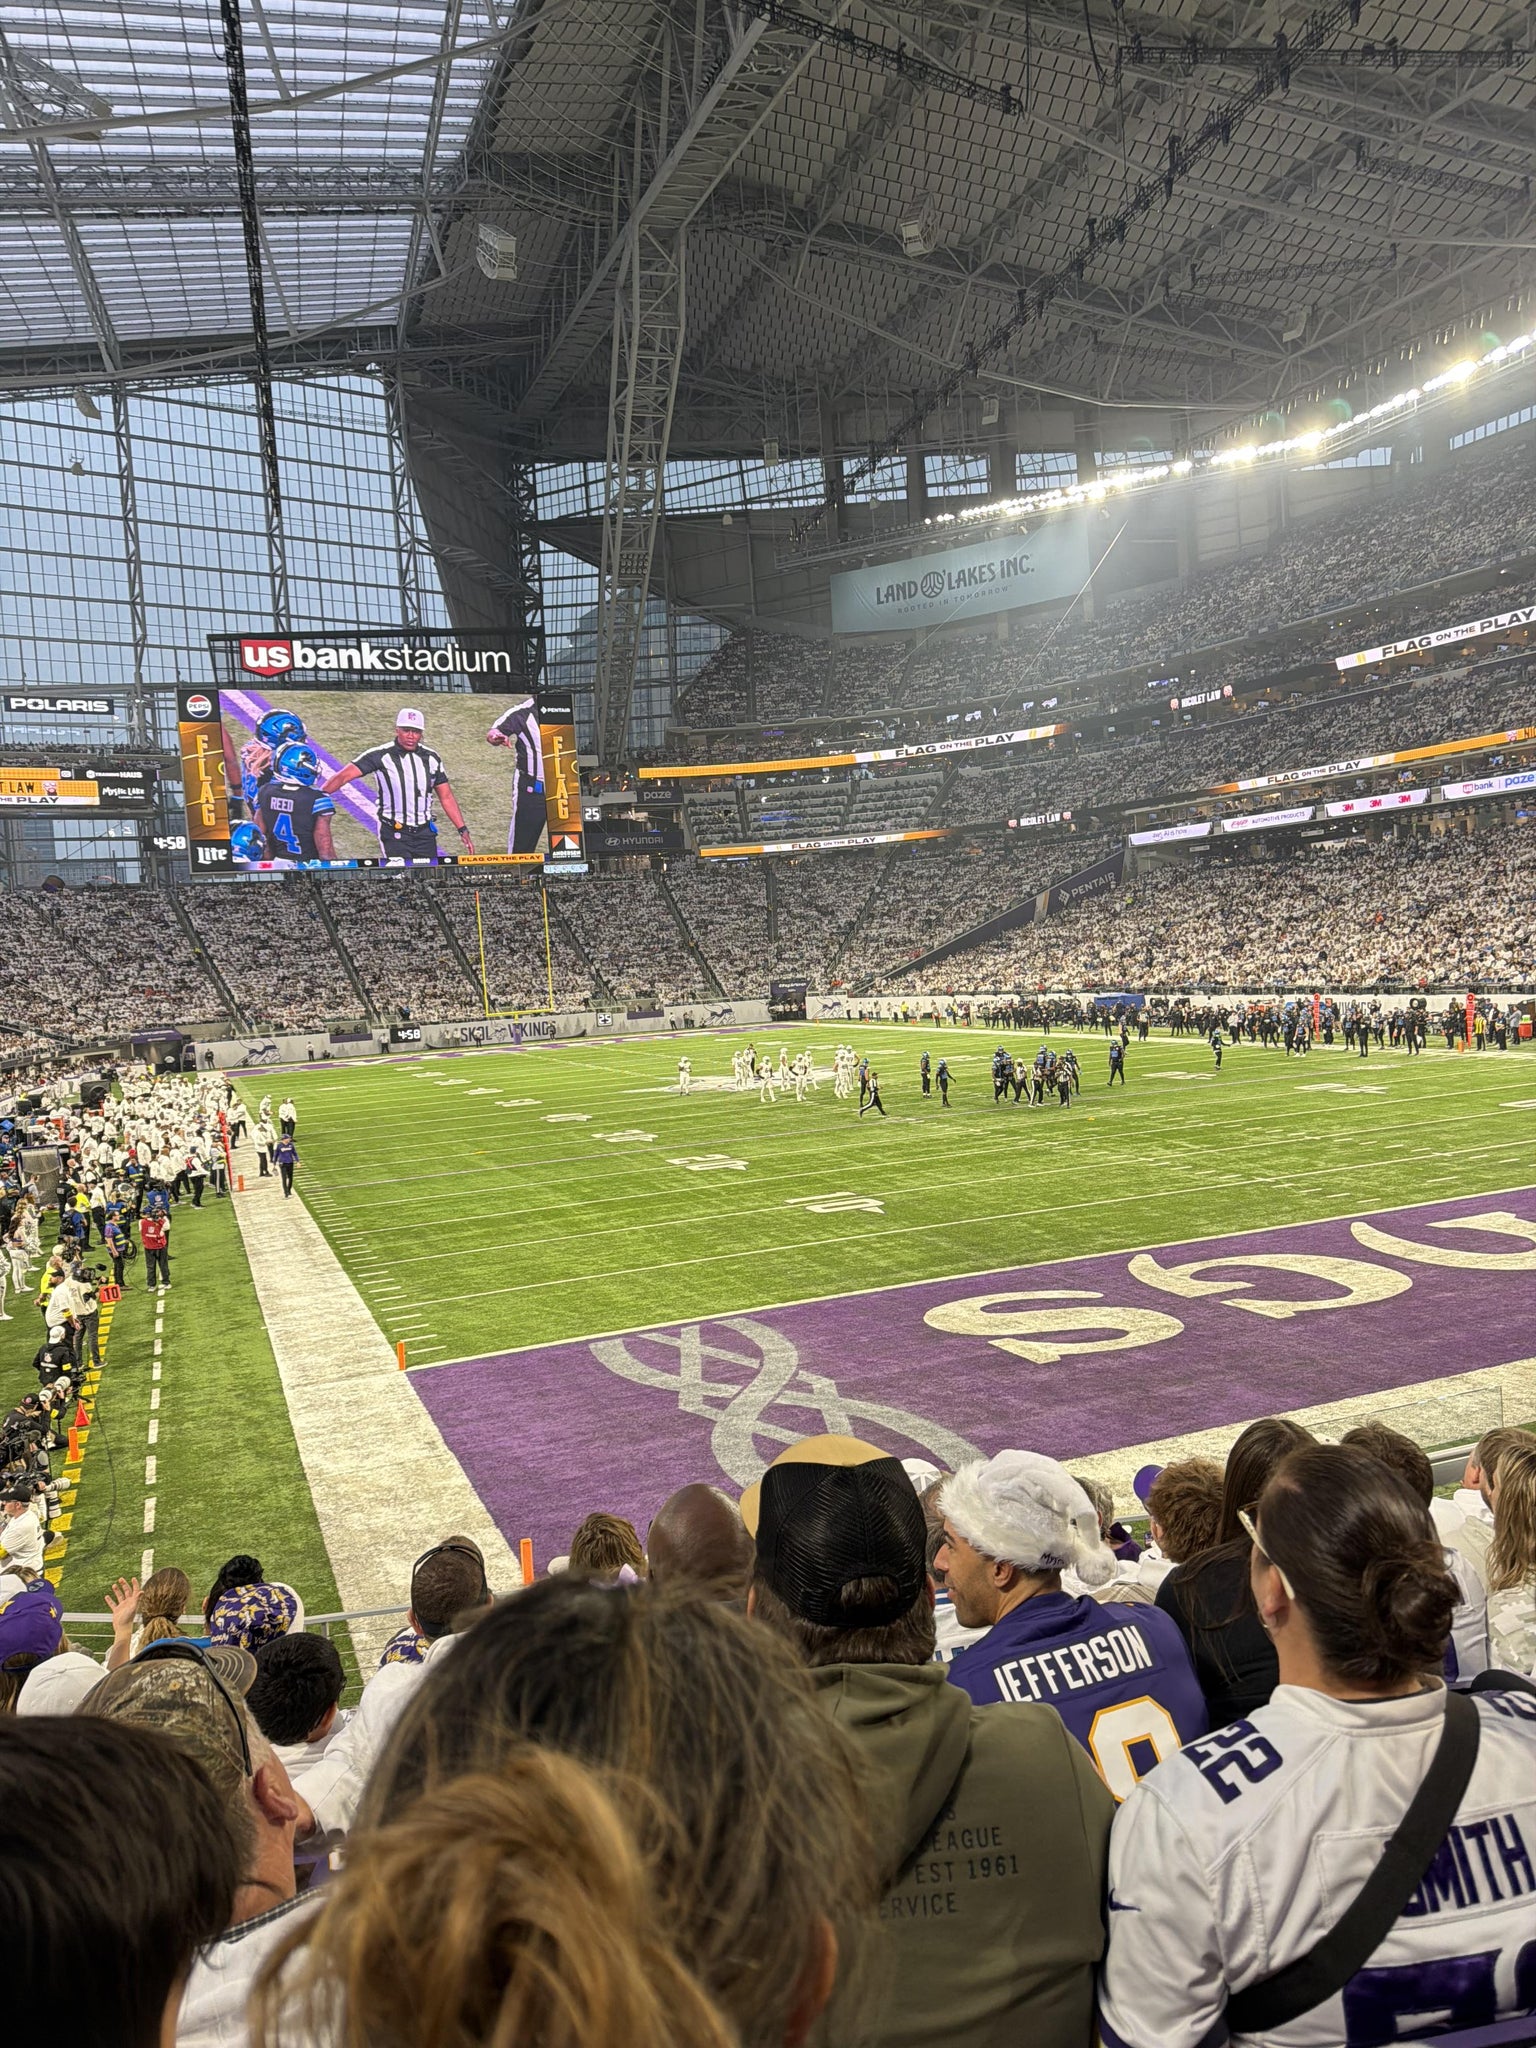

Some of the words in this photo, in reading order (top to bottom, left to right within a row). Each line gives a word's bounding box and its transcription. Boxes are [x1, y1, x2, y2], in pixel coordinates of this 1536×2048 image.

[876, 581, 918, 605] LAND
[1000, 554, 1035, 579] INC.
[898, 601, 934, 614] ROOTED
[954, 587, 1009, 602] TOMORROW
[1382, 637, 1432, 658] FLAG
[1435, 632, 1451, 642] ON
[1455, 625, 1476, 638] THE
[1480, 608, 1535, 633] PLAY
[10, 698, 109, 712] POLARIS
[895, 744, 937, 757] FLAG
[975, 733, 1015, 746] PLAY
[196, 735, 215, 826] FLAG
[553, 736, 569, 820] FLAG
[1267, 773, 1299, 784] FLAG
[1329, 761, 1360, 773] PLAY
[1474, 780, 1493, 791] bank
[1505, 774, 1535, 787] paze
[9, 782, 34, 793] LAW
[643, 791, 672, 800] paze
[271, 796, 294, 813] REED
[585, 808, 600, 820] 25
[1342, 803, 1354, 812] 3M
[1369, 799, 1381, 808] 3M
[1398, 794, 1411, 804] 3M
[154, 836, 187, 849] 4:58
[273, 813, 303, 854] 4
[622, 837, 663, 845] HYUNDAI
[847, 837, 876, 845] PLAY
[197, 846, 229, 864] Lite
[1071, 872, 1115, 898] PENTAIR
[398, 1029, 420, 1040] 4:58
[103, 1286, 119, 1300] 10
[993, 1625, 1153, 1702] JEFFERSON
[932, 1827, 1003, 1853] EAGUE
[915, 1862, 955, 1884] EST
[968, 1854, 1019, 1880] 1961
[1402, 1814, 1536, 1917] MITH
[878, 1893, 960, 1920] ERVICE
